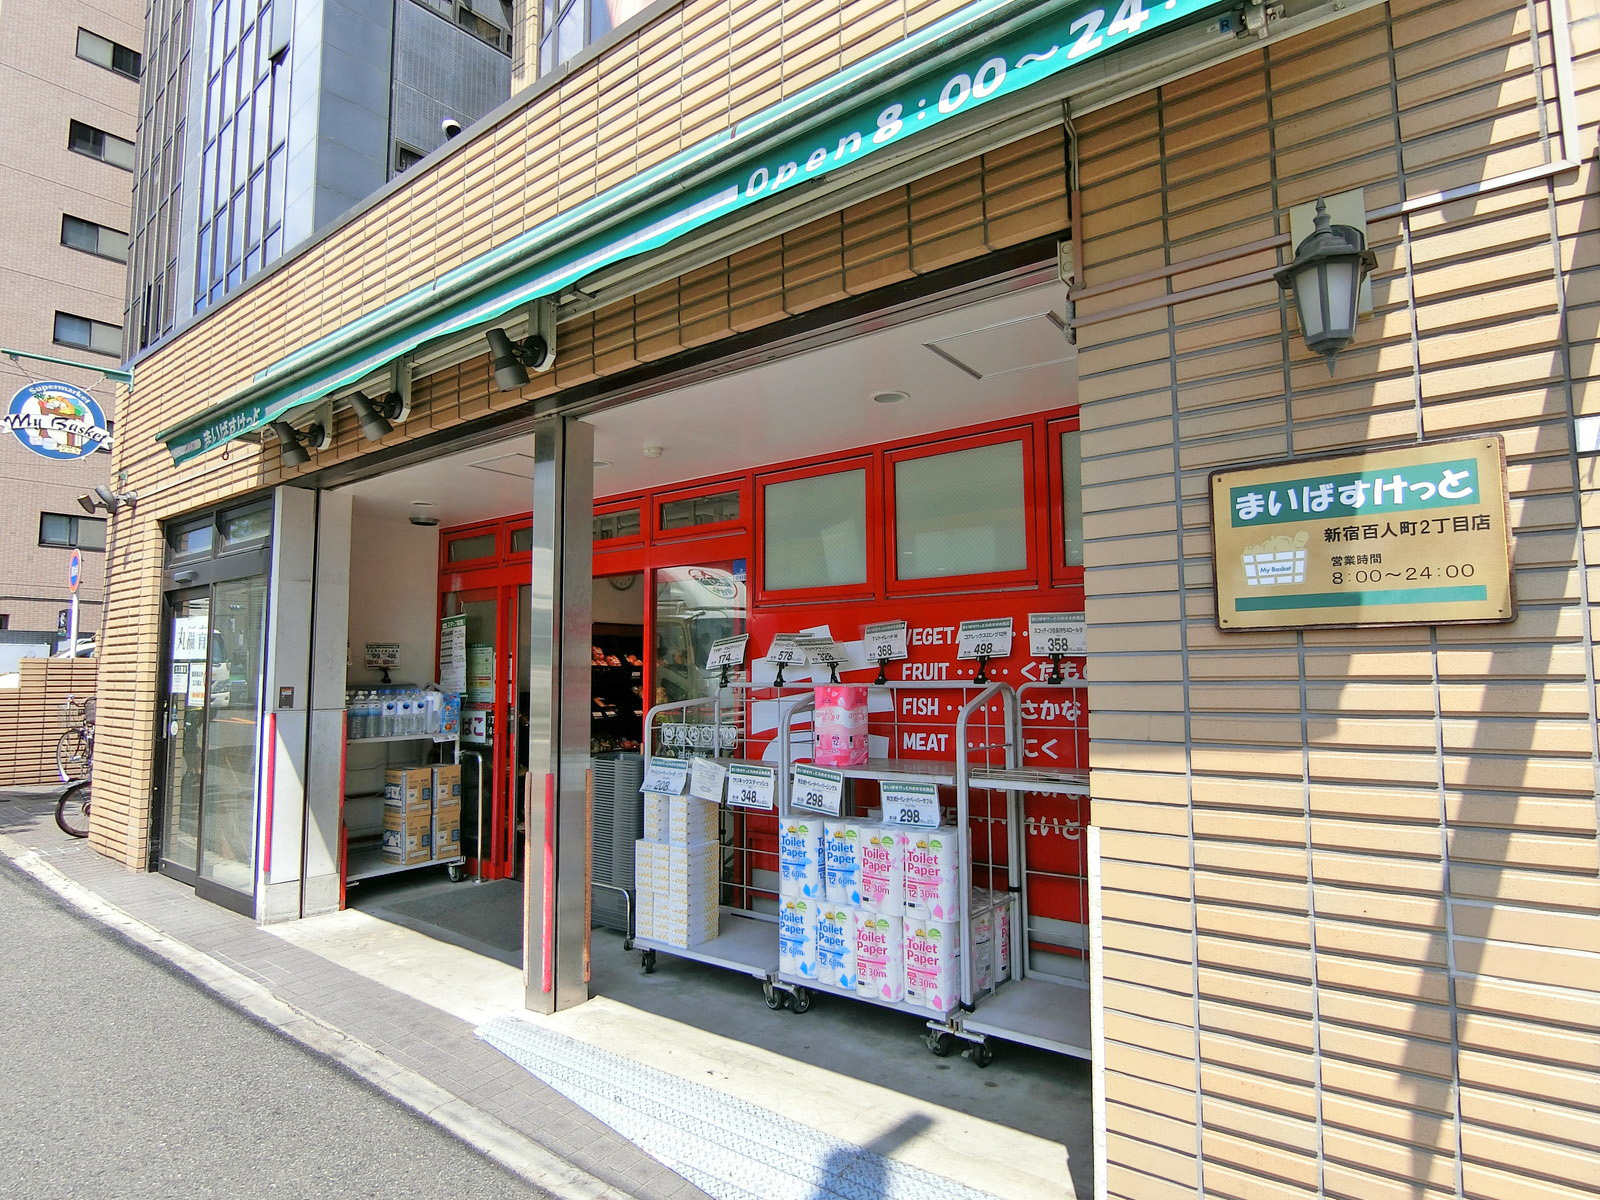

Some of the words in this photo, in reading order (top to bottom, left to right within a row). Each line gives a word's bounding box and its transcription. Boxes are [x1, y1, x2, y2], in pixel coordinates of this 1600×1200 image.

[745, 131, 862, 198] Open
[29, 384, 91, 405] Supermarket
[4, 413, 42, 430] My
[51, 416, 108, 444] Basket
[203, 407, 261, 450] まいばすけっと
[1235, 468, 1473, 520] まいばすけっと
[1323, 514, 1491, 543] 新宿百人町2丁目店
[1331, 553, 1382, 567] 営業時間
[1260, 566, 1270, 574] My
[1272, 564, 1292, 573] Basket
[877, 644, 893, 657] 368
[974, 643, 993, 655] 498
[1047, 638, 1069, 652] 358
[719, 653, 731, 664] 174
[778, 651, 794, 661] 578
[817, 652, 834, 661] 328
[902, 662, 950, 681] FRUIT
[902, 698, 939, 716] FISH
[1020, 700, 1081, 722] さかな
[903, 732, 949, 752] MEAT
[1022, 738, 1059, 760] にく
[654, 780, 671, 791] 208
[741, 789, 757, 803] 348
[806, 791, 823, 808] 298
[900, 809, 920, 824] 298
[781, 836, 806, 848] Toilet
[827, 841, 854, 853] Toilet
[781, 846, 807, 858] Paper
[827, 852, 856, 864] Paper
[862, 846, 890, 861] Toilet
[907, 851, 939, 865] Toilet
[862, 858, 892, 872] Paper
[907, 862, 940, 877] Paper
[783, 870, 790, 878] 12
[828, 877, 836, 885] 12
[863, 884, 871, 893] 12
[909, 889, 917, 898] 12
[780, 910, 804, 925] Toilet
[780, 921, 805, 935] Paper
[818, 921, 844, 936] Toilet
[818, 932, 845, 947] Paper
[857, 929, 886, 944] Toilet
[780, 946, 787, 954] 12
[857, 940, 888, 955] Paper
[907, 937, 938, 954] Toilet
[820, 957, 827, 966] 12
[907, 949, 940, 965] Paper
[858, 968, 866, 977] 12
[909, 977, 917, 986] 12
